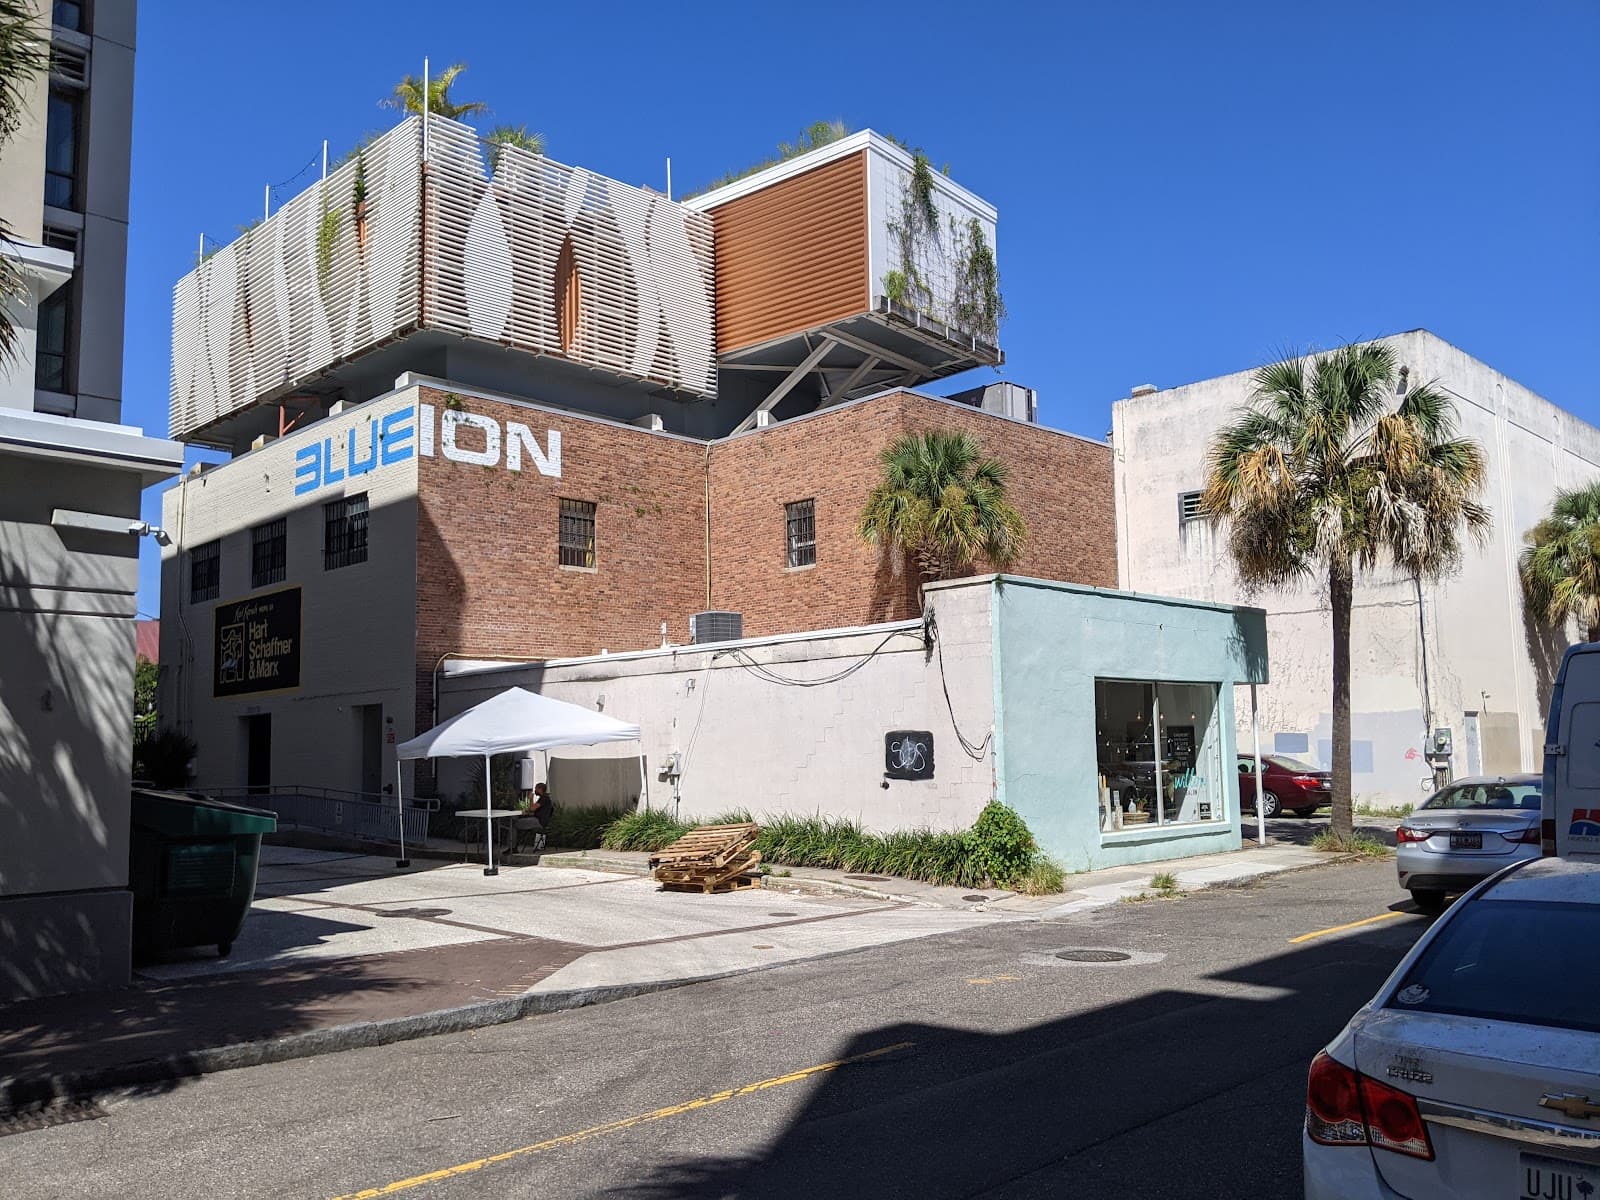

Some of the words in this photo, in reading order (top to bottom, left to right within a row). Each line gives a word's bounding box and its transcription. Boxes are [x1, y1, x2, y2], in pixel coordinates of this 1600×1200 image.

[420, 403, 562, 478] ION
[249, 619, 268, 640] Hart
[249, 637, 292, 660] Schaffner
[249, 661, 256, 679] &
[256, 660, 279, 678] Marx
